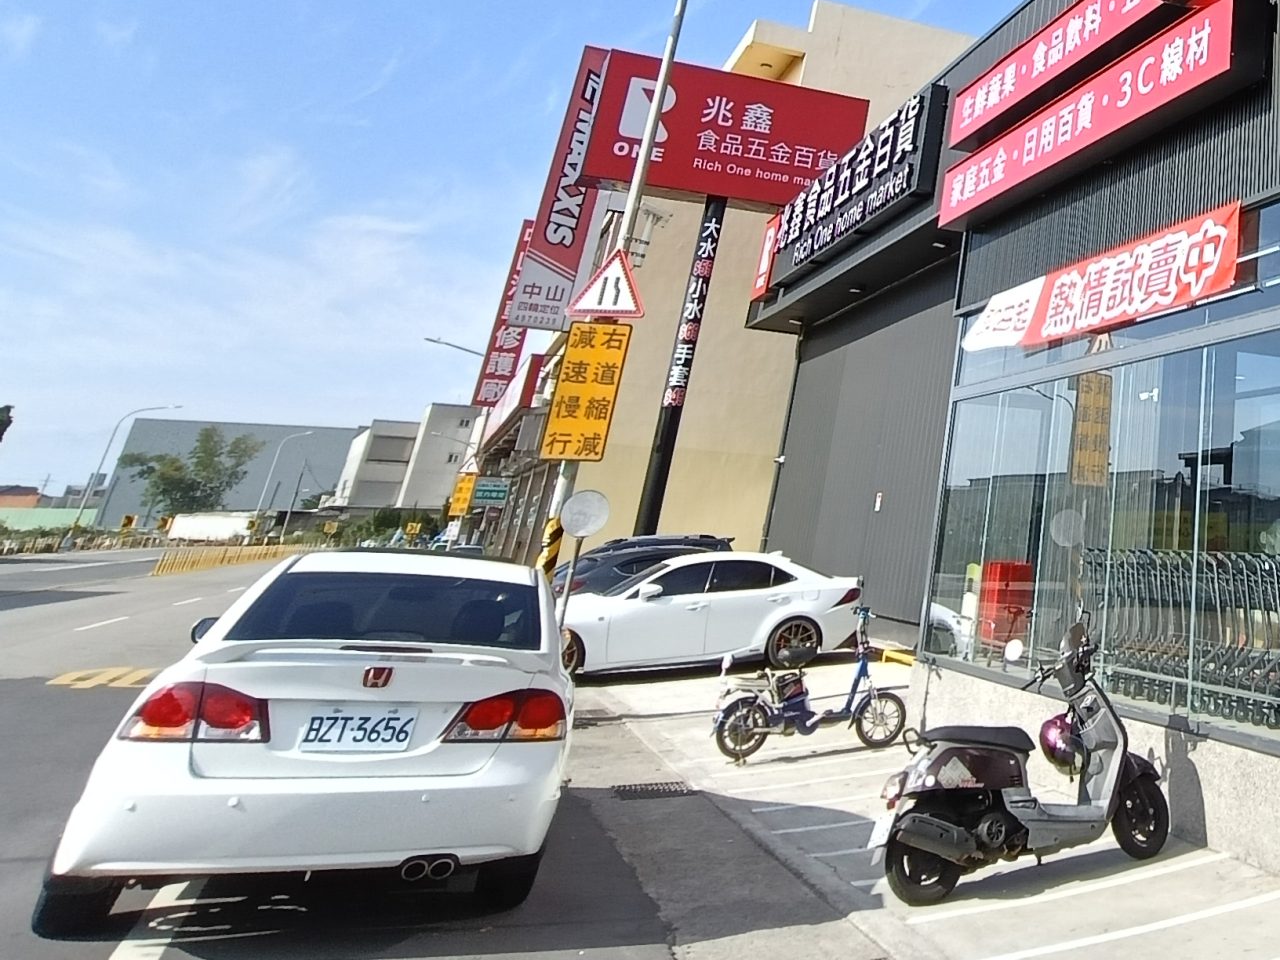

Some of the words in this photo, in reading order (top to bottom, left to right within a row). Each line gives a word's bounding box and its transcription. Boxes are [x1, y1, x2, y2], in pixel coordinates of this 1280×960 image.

[701, 95, 774, 135] 兆鑫
[693, 158, 722, 173] Rich
[726, 163, 752, 178] One
[755, 167, 789, 184] home
[696, 129, 838, 171] 食品五金百貨
[813, 222, 833, 249] One
[834, 201, 864, 237] home
[865, 165, 910, 216] market
[522, 282, 565, 302] 中山
[545, 326, 599, 456] 減速慢行
[573, 328, 627, 457] 右道縮減
